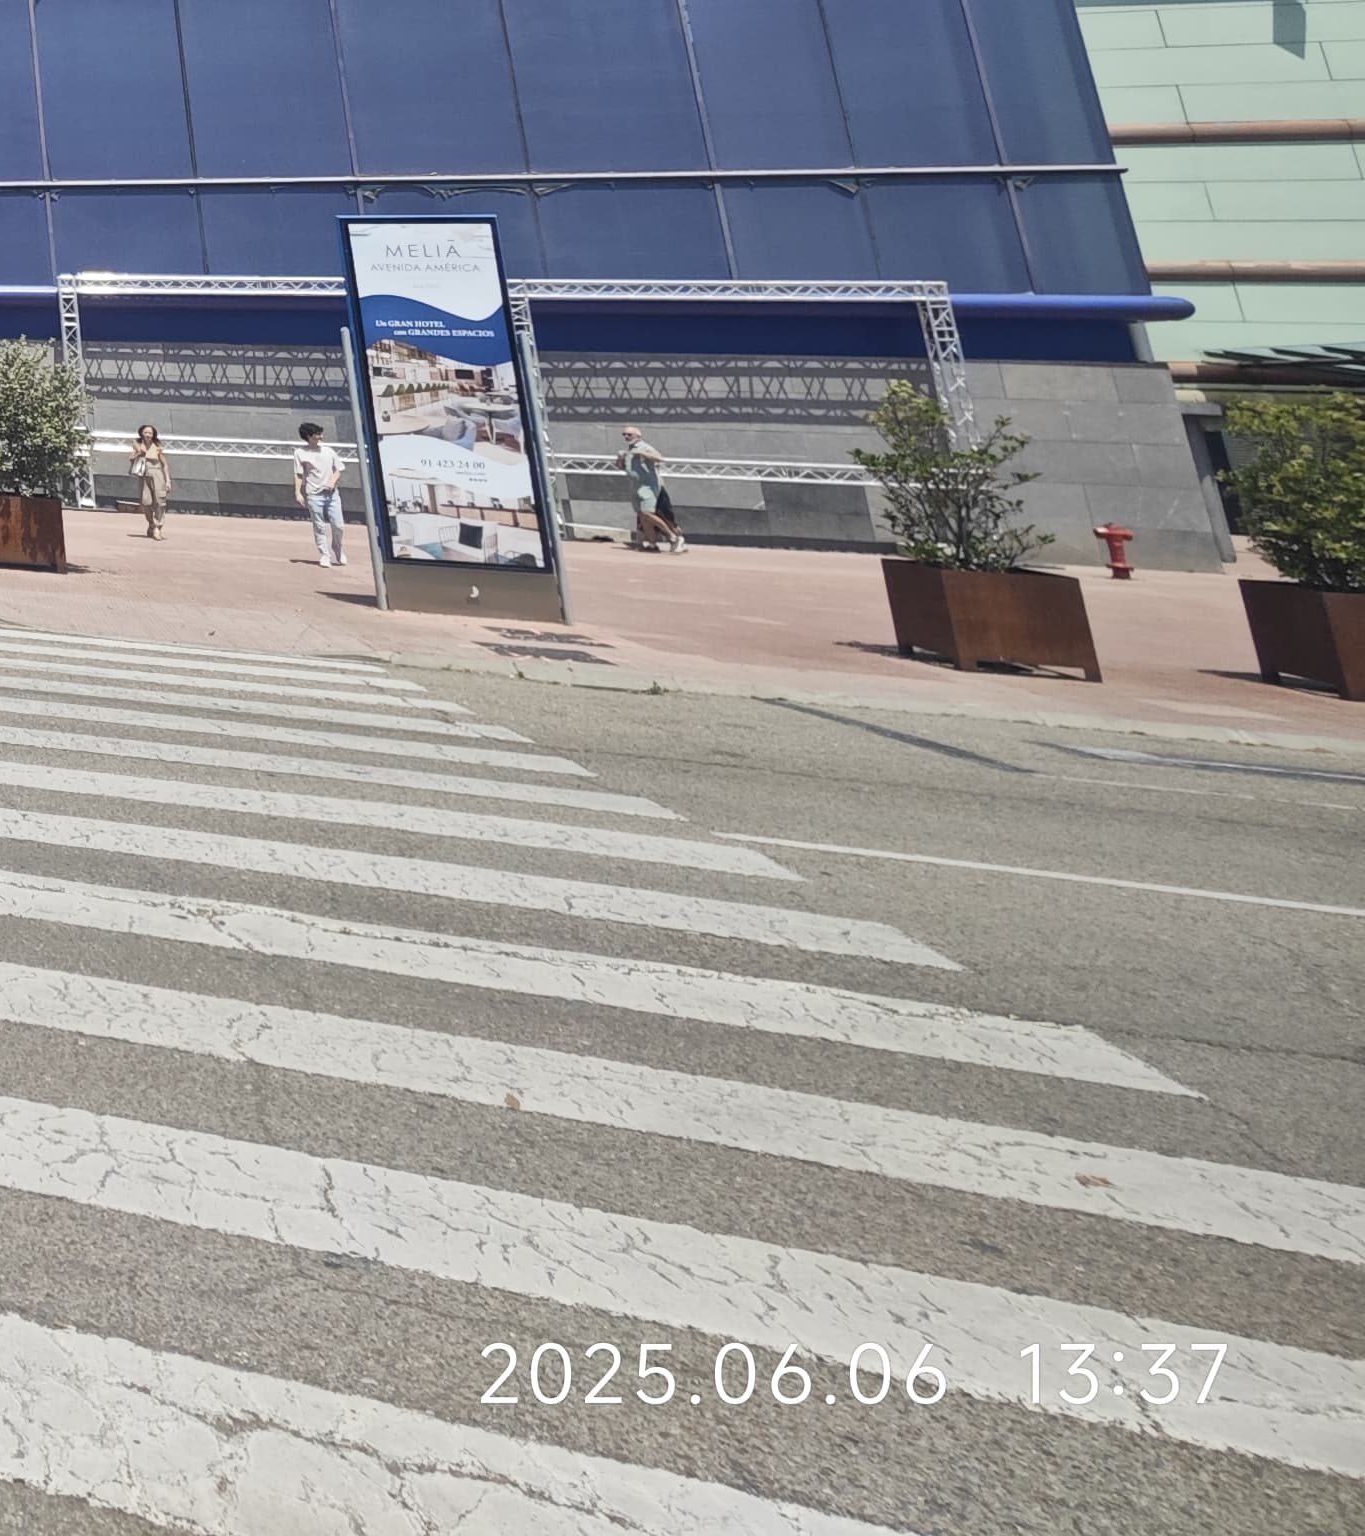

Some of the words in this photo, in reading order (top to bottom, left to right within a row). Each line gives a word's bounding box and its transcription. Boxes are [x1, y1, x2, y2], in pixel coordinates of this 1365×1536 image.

[370, 263, 421, 272] AVENIDA
[424, 262, 481, 272] AMÉRICA
[388, 319, 414, 328] GRAN
[414, 320, 446, 328] HOTEL
[408, 329, 451, 337] GRANDES
[452, 330, 495, 338] ESPACIOS
